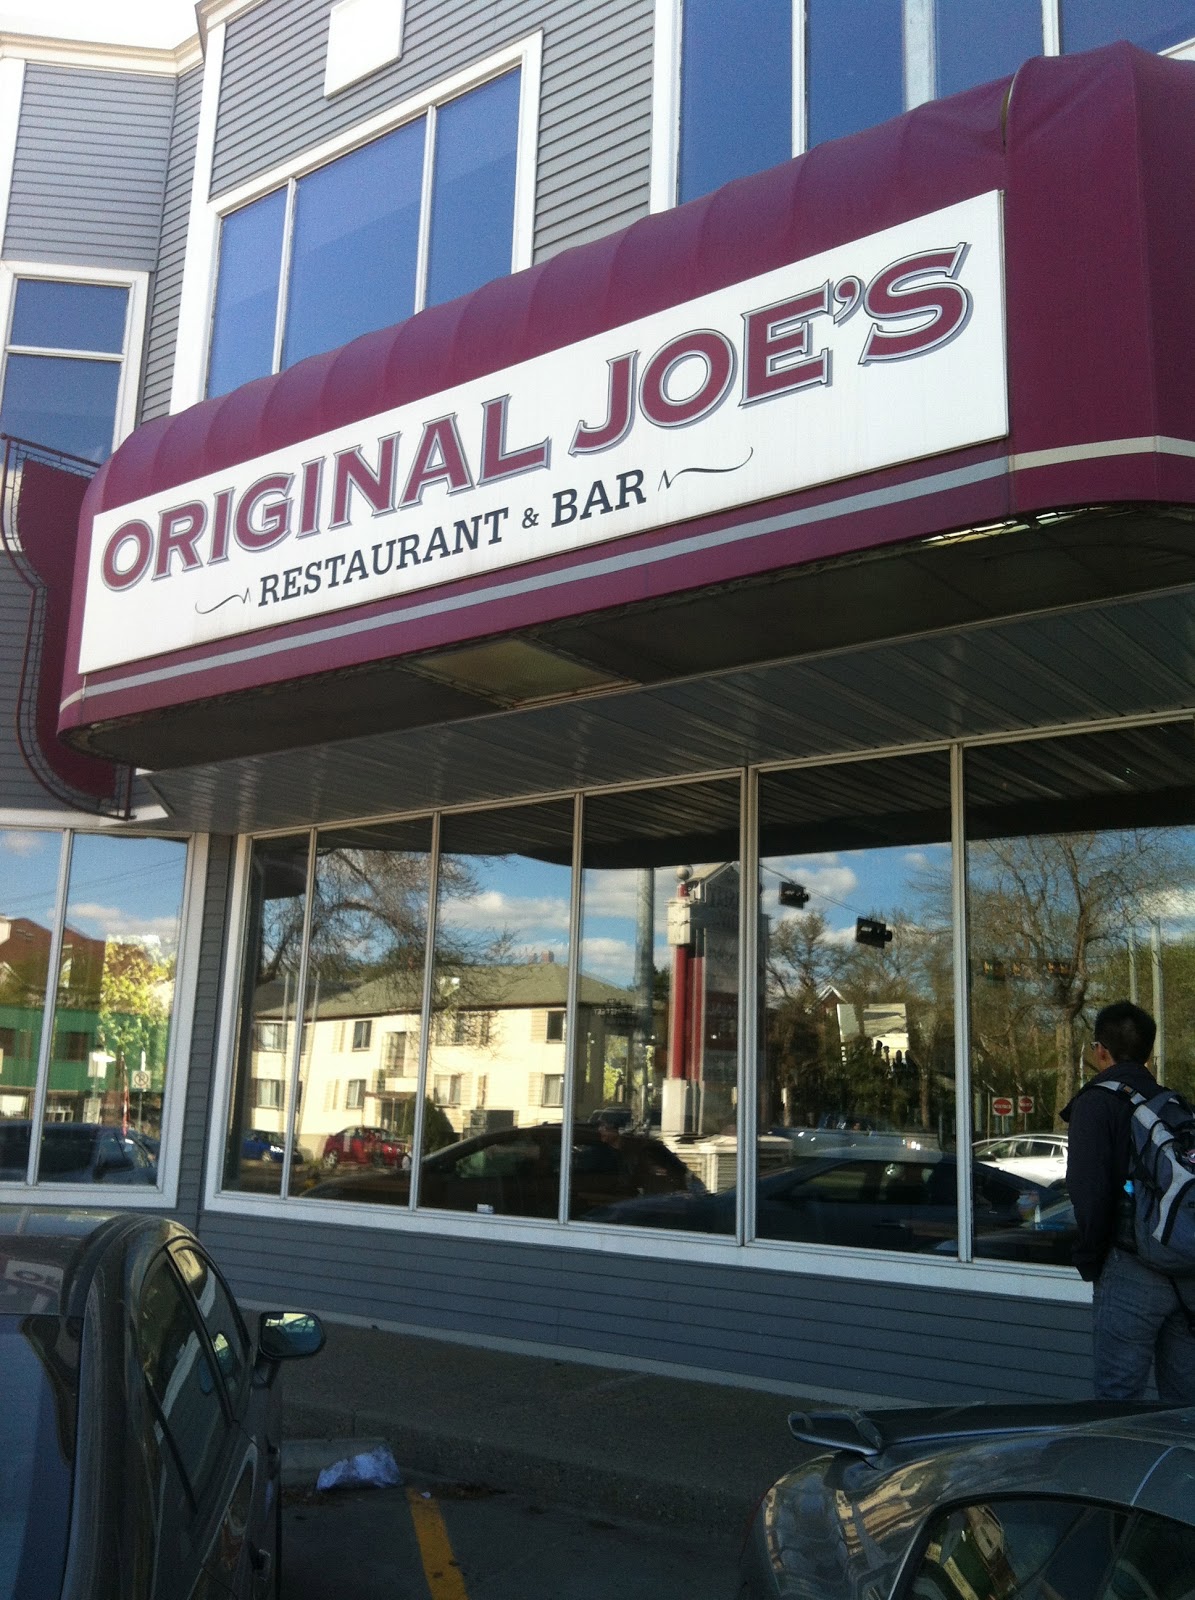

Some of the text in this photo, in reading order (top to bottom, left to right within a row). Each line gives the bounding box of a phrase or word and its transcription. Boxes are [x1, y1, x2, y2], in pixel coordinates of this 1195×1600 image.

[101, 241, 974, 592] ORIGINAL JOE'S
[258, 469, 647, 607] RESTAURANT & BAR
